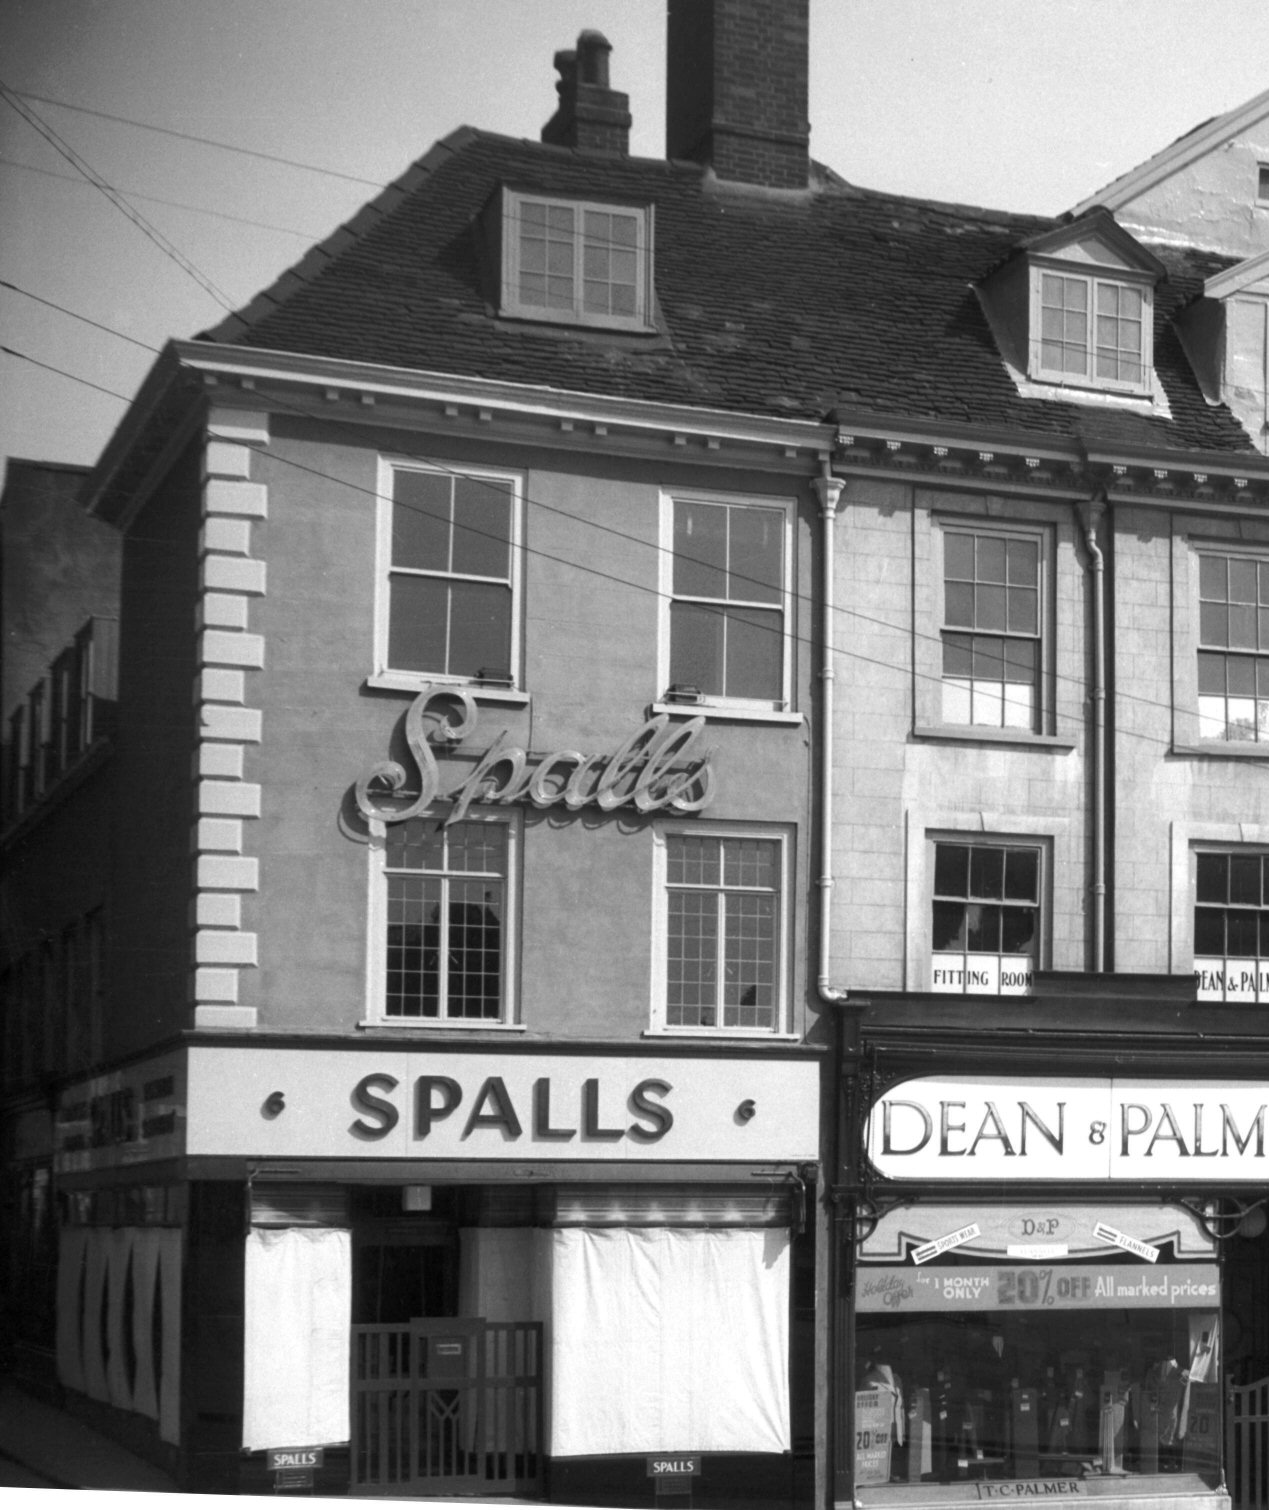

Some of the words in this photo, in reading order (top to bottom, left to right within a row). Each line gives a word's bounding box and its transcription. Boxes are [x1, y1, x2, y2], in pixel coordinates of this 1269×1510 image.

[355, 685, 721, 828] Spalls
[933, 968, 989, 986] FITTING
[1001, 970, 1034, 988] ROOM
[1227, 976, 1239, 993] &
[261, 1090, 286, 1120] 6
[347, 1072, 675, 1145] SPALLS
[734, 1098, 757, 1126] 6
[879, 1099, 1067, 1157] DEAN
[1119, 1235, 1156, 1259] FLANNELS
[916, 1270, 931, 1285] for
[934, 1277, 940, 1289] 1
[943, 1276, 990, 1288] MONTH
[998, 1268, 1056, 1305] 20%
[1056, 1275, 1092, 1298] OFF
[1095, 1275, 1115, 1298] All
[1117, 1275, 1168, 1298] marked
[1170, 1277, 1218, 1305] prices
[943, 1286, 982, 1300] ONLY
[273, 1452, 317, 1467] SPALLS
[653, 1460, 695, 1474] SPALLS
